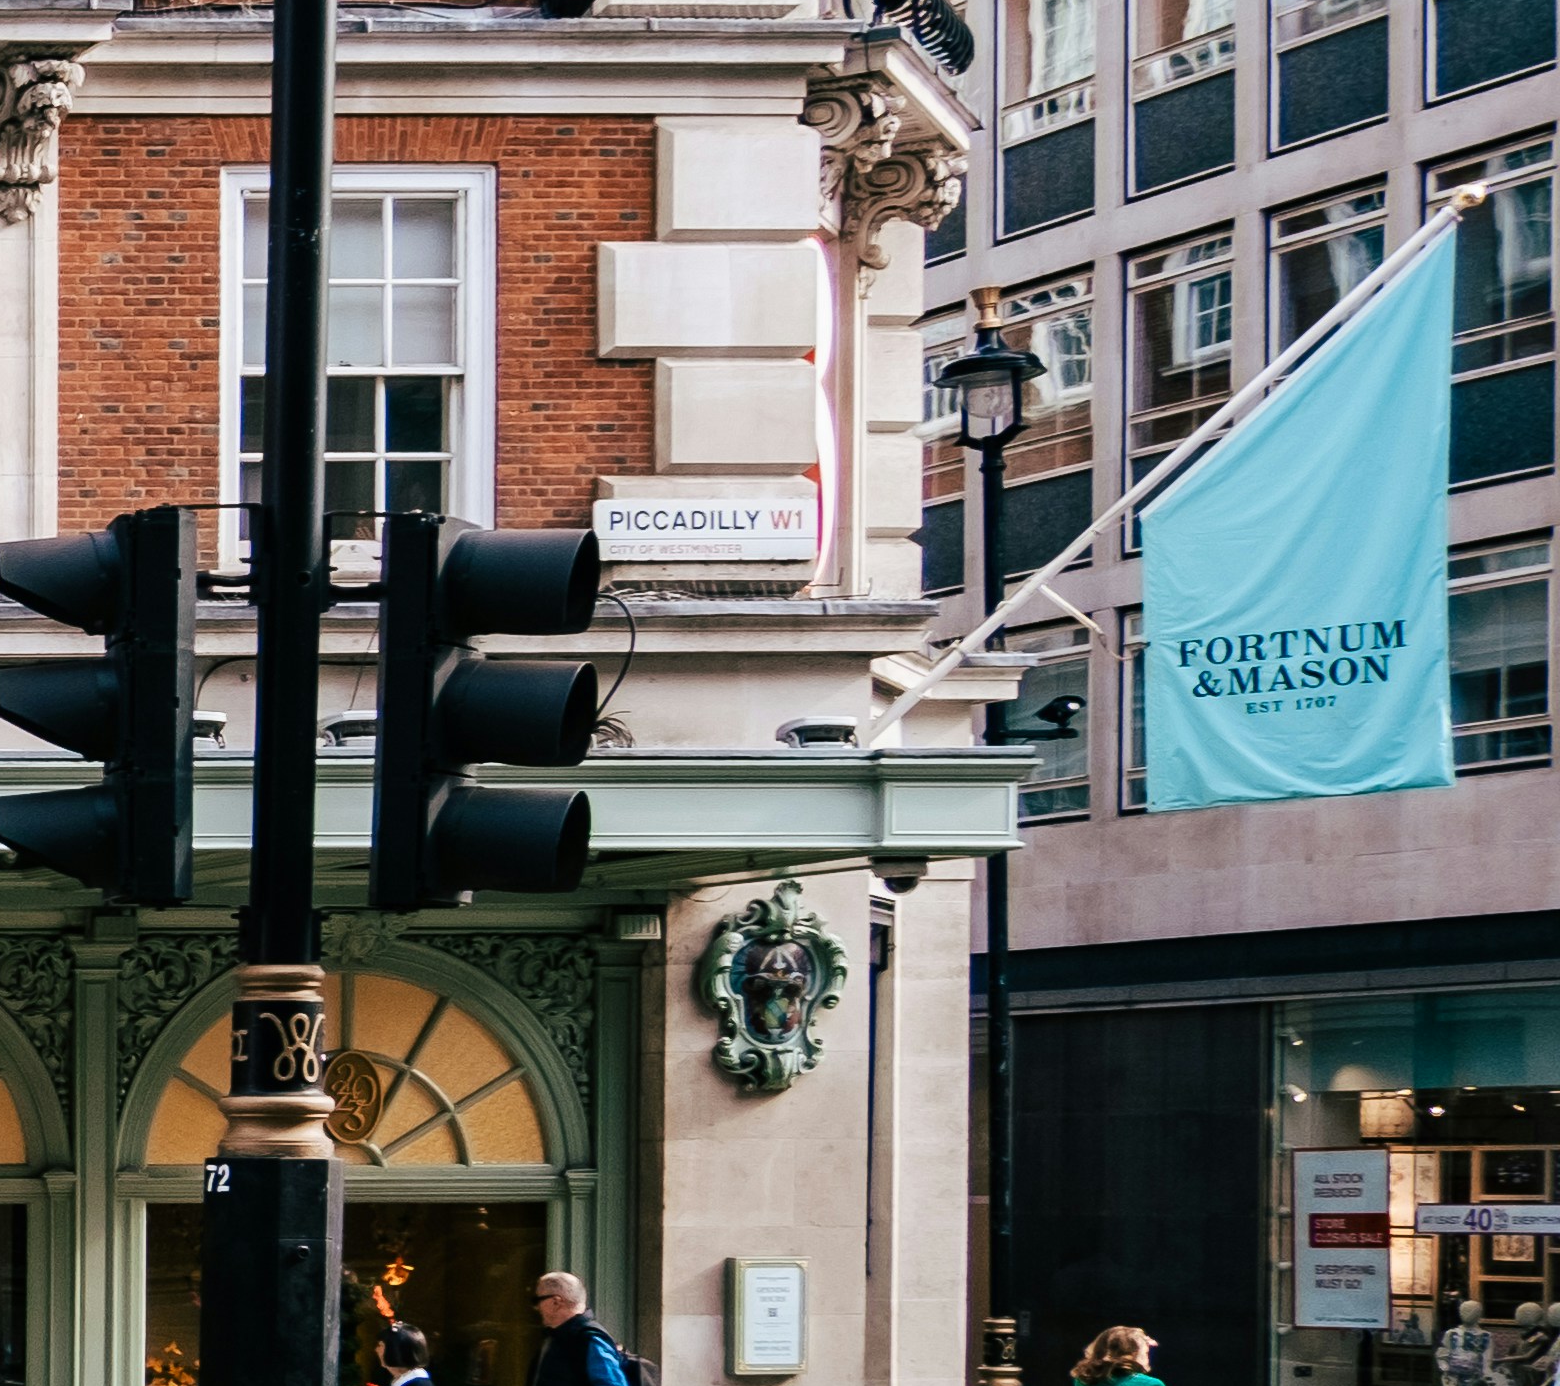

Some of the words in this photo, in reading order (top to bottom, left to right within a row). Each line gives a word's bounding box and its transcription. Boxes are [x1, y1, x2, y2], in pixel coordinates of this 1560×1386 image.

[609, 510, 760, 530] PICCADILLY
[770, 510, 802, 530] W1
[610, 545, 635, 555] CITY
[640, 545, 654, 554] OF
[659, 544, 742, 554] WESTMINSTER
[1177, 620, 1409, 667] FORTNUM
[1246, 700, 1283, 714] EST
[1295, 695, 1337, 711] 1707
[205, 1164, 230, 1192] 72
[1314, 1174, 1330, 1184] ALL
[1332, 1173, 1364, 1184] STOCK
[1315, 1218, 1346, 1229] STORE
[1462, 1208, 1492, 1231] 40
[1315, 1233, 1357, 1243] CLOSING
[1359, 1233, 1383, 1243] SALE
[1315, 1265, 1376, 1275] EVERYTHING
[1315, 1278, 1342, 1289] MUST
